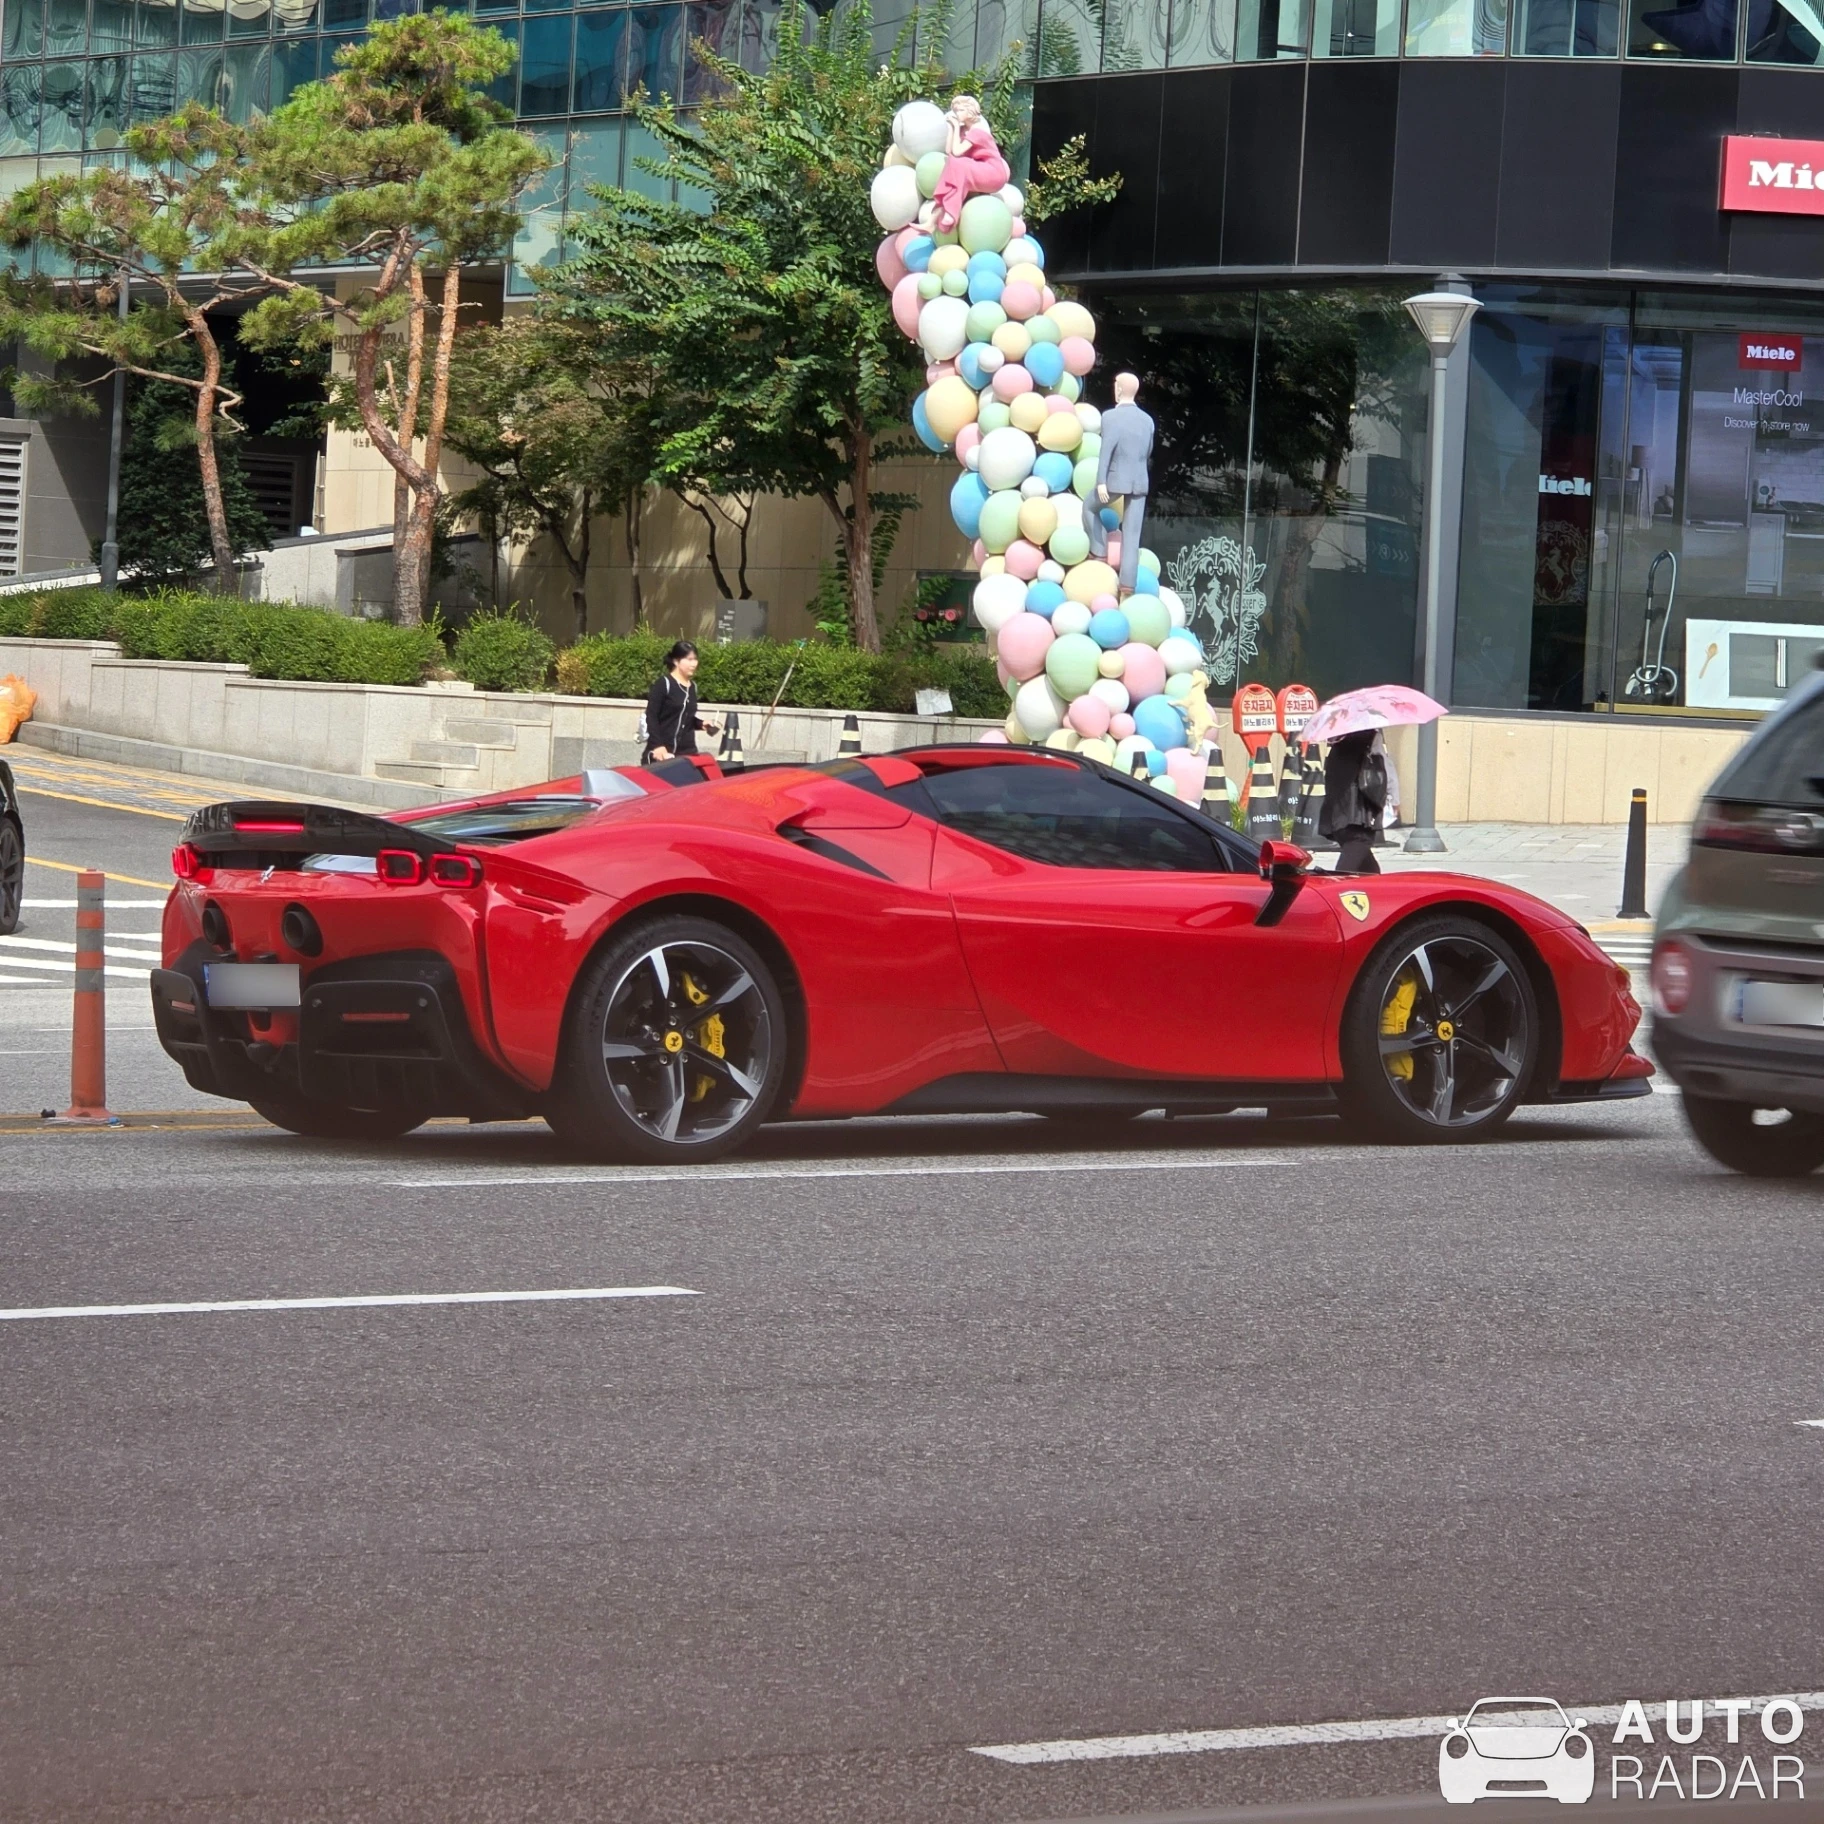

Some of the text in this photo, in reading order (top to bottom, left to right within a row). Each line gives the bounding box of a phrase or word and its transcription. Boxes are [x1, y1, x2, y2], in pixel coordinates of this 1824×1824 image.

[1746, 345, 1796, 361] Miele
[1733, 387, 1803, 407] MasterCool
[1724, 416, 1758, 429] Discover
[1792, 421, 1810, 432] now
[1243, 699, 1273, 712] 주차금지
[1286, 700, 1315, 712] 주차금지
